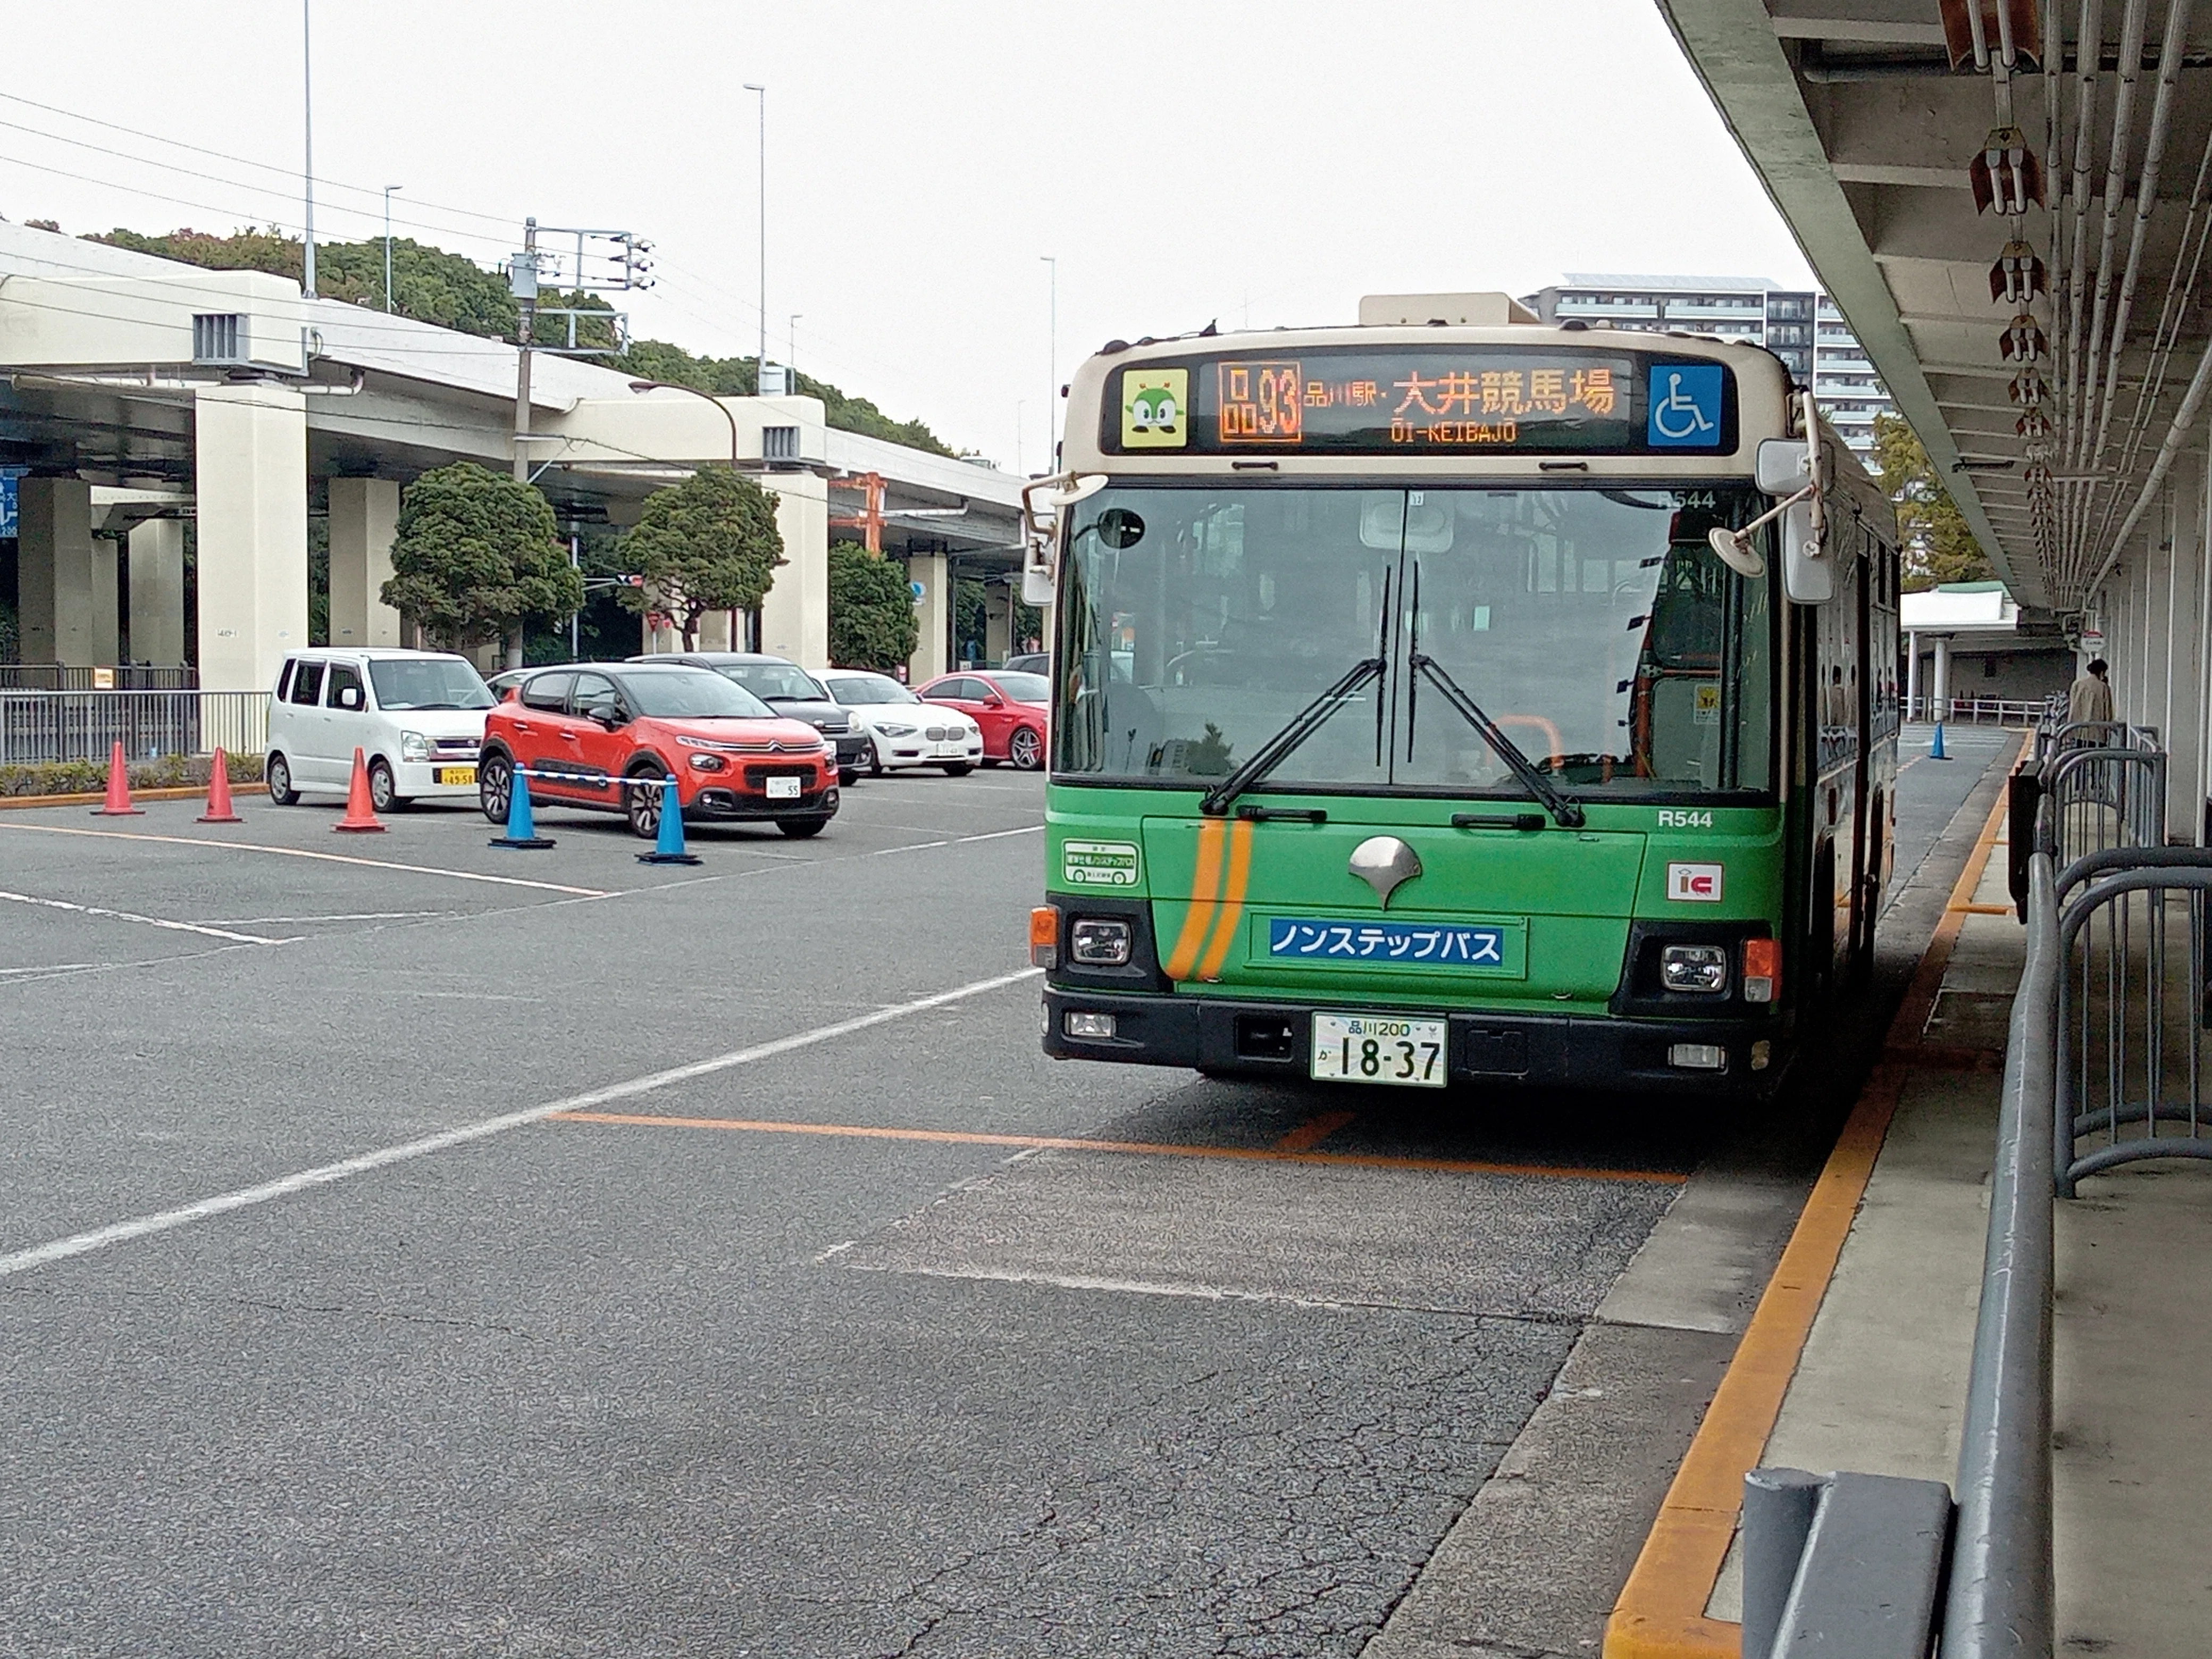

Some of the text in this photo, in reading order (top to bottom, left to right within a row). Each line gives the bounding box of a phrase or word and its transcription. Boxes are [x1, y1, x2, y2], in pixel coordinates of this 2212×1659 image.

[1224, 368, 1298, 434] 品93
[1658, 810, 1713, 828] R544
[1272, 925, 1501, 961] ノンステップバス
[1342, 1037, 1440, 1080] 18-37
